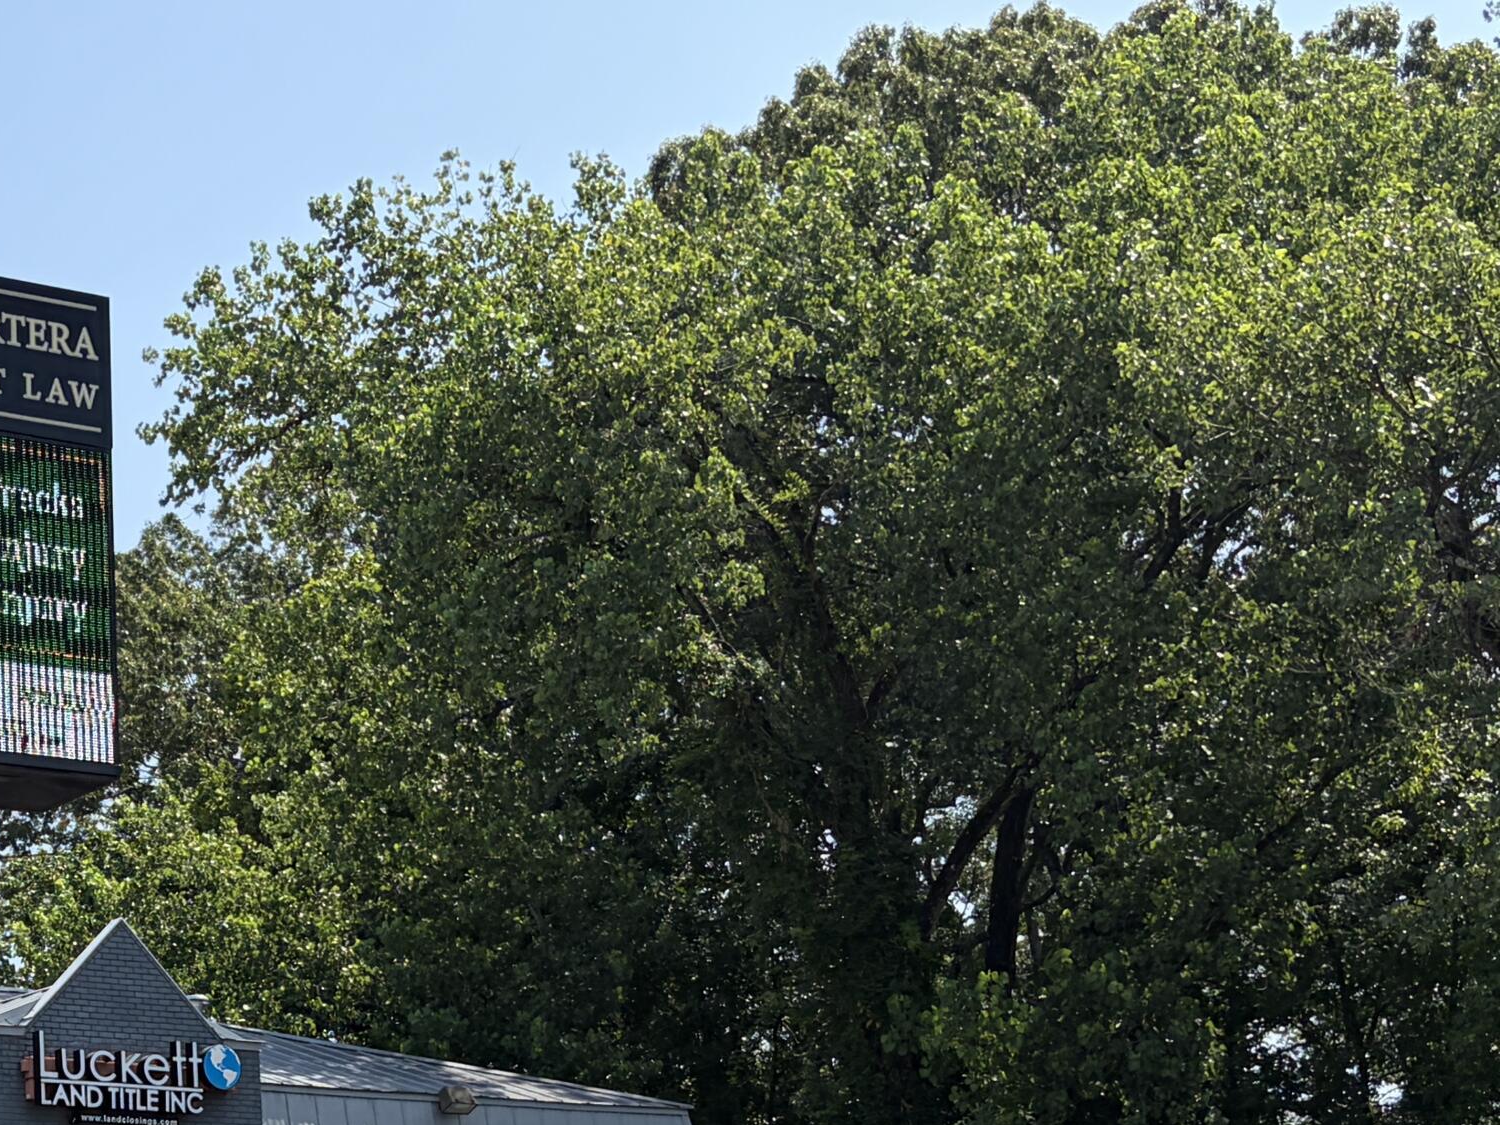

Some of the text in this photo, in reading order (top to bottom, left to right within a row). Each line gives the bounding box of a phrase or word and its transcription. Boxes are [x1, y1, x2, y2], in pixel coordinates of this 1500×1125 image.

[23, 373, 100, 410] LAW
[37, 1030, 202, 1088] Luckett
[40, 1083, 204, 1114] LAND TITLE INC
